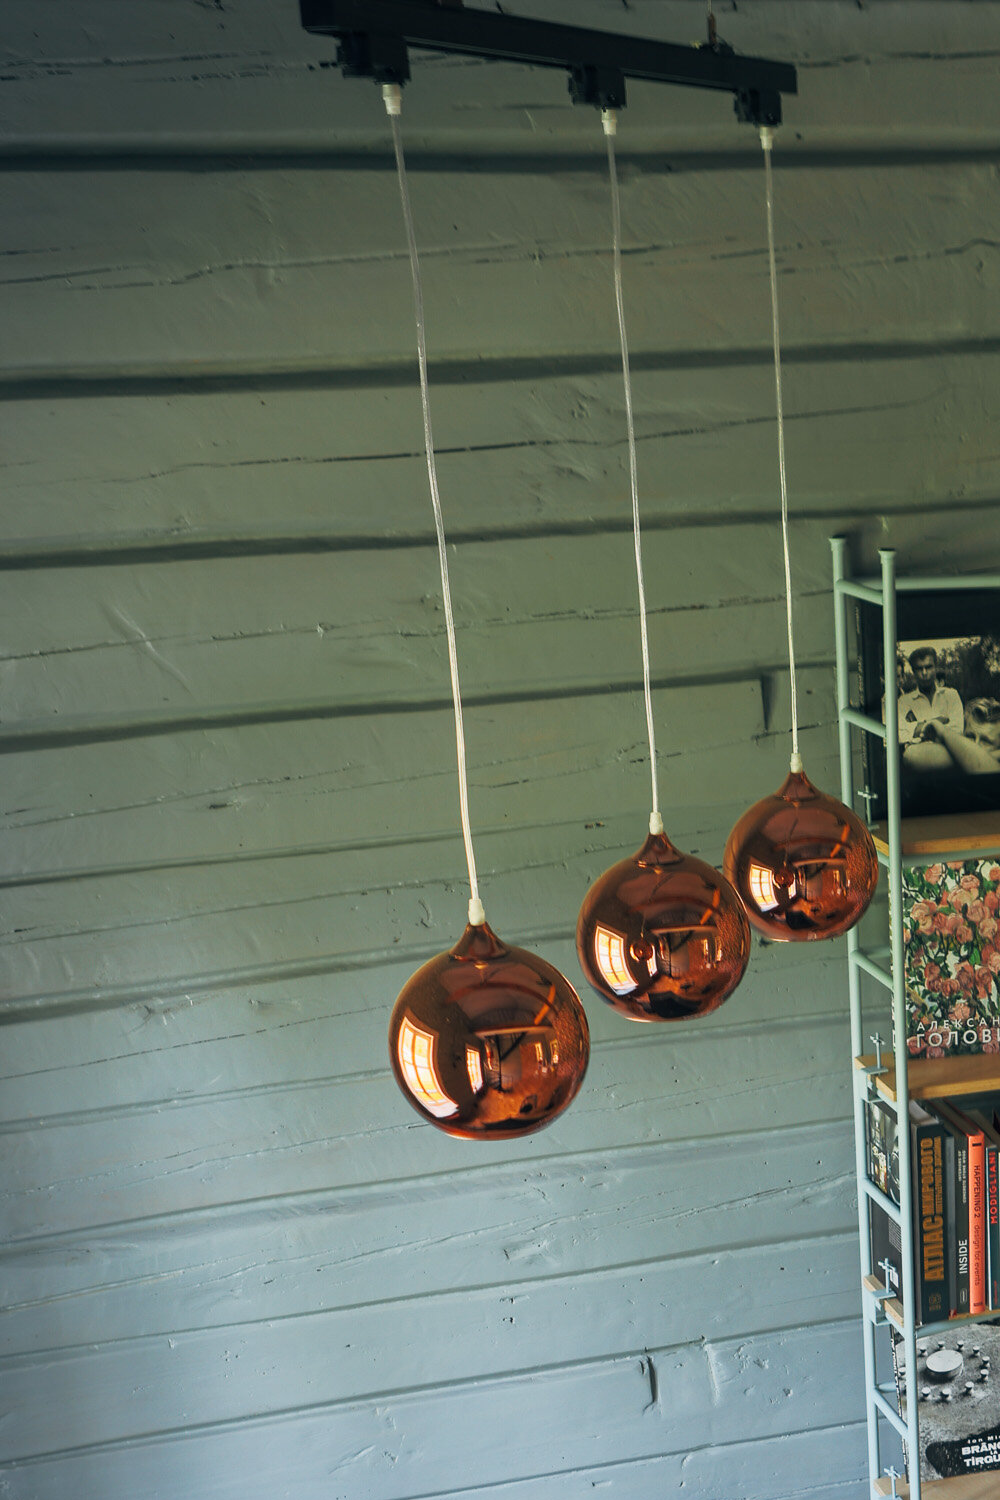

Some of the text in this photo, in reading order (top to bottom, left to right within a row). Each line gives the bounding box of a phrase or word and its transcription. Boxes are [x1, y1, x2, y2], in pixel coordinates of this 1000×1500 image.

[920, 1137, 935, 1216] МИРОВОГО
[973, 1165, 981, 1211] HAPPENING
[989, 1152, 998, 1224] MODIGLIANI
[923, 1215, 944, 1282] АТЛАС
[958, 1239, 968, 1274] INSIDE
[973, 1224, 981, 1249] design
